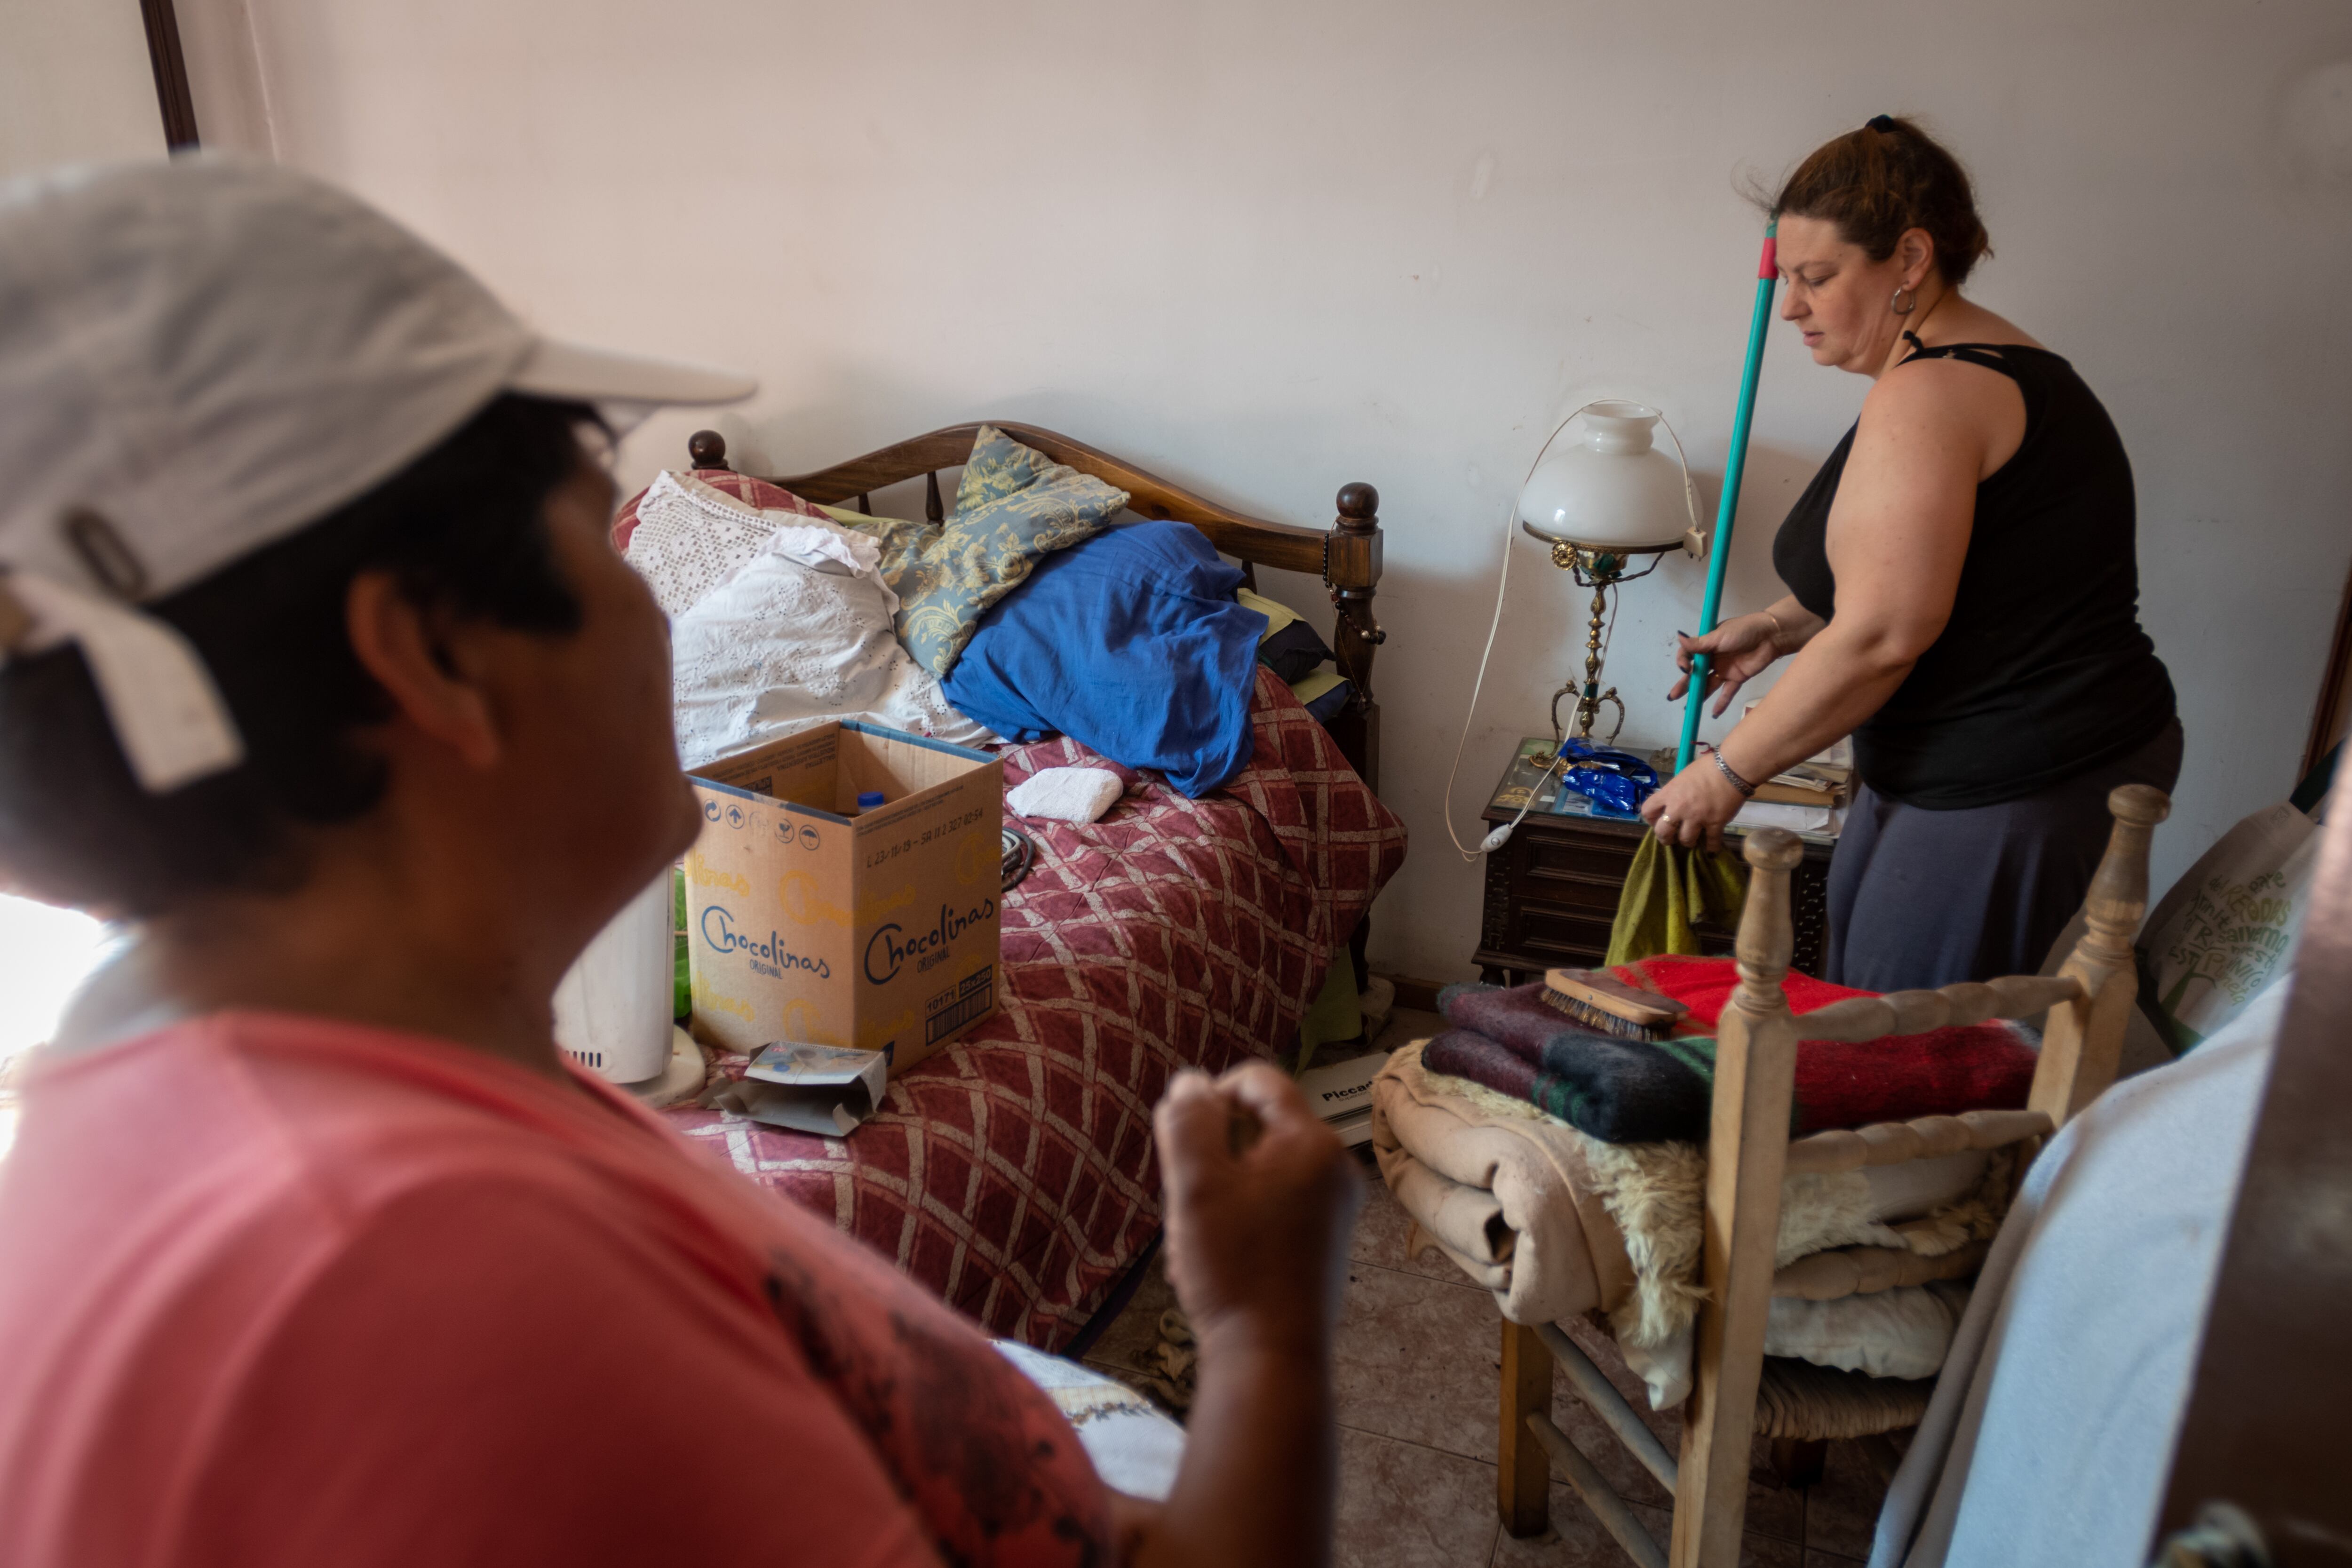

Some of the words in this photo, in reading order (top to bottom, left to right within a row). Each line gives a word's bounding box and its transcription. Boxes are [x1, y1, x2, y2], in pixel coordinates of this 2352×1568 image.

[874, 840, 911, 865] 23/11/19
[948, 817, 961, 833] 327
[964, 807, 983, 826] 02:54
[701, 906, 830, 979] Chocolinas
[864, 899, 994, 985] Chocolinas
[750, 959, 783, 979] ORIGINAL
[917, 946, 950, 973] ORIGINAL
[961, 969, 991, 995] 25x250
[927, 989, 955, 1012] 10171
